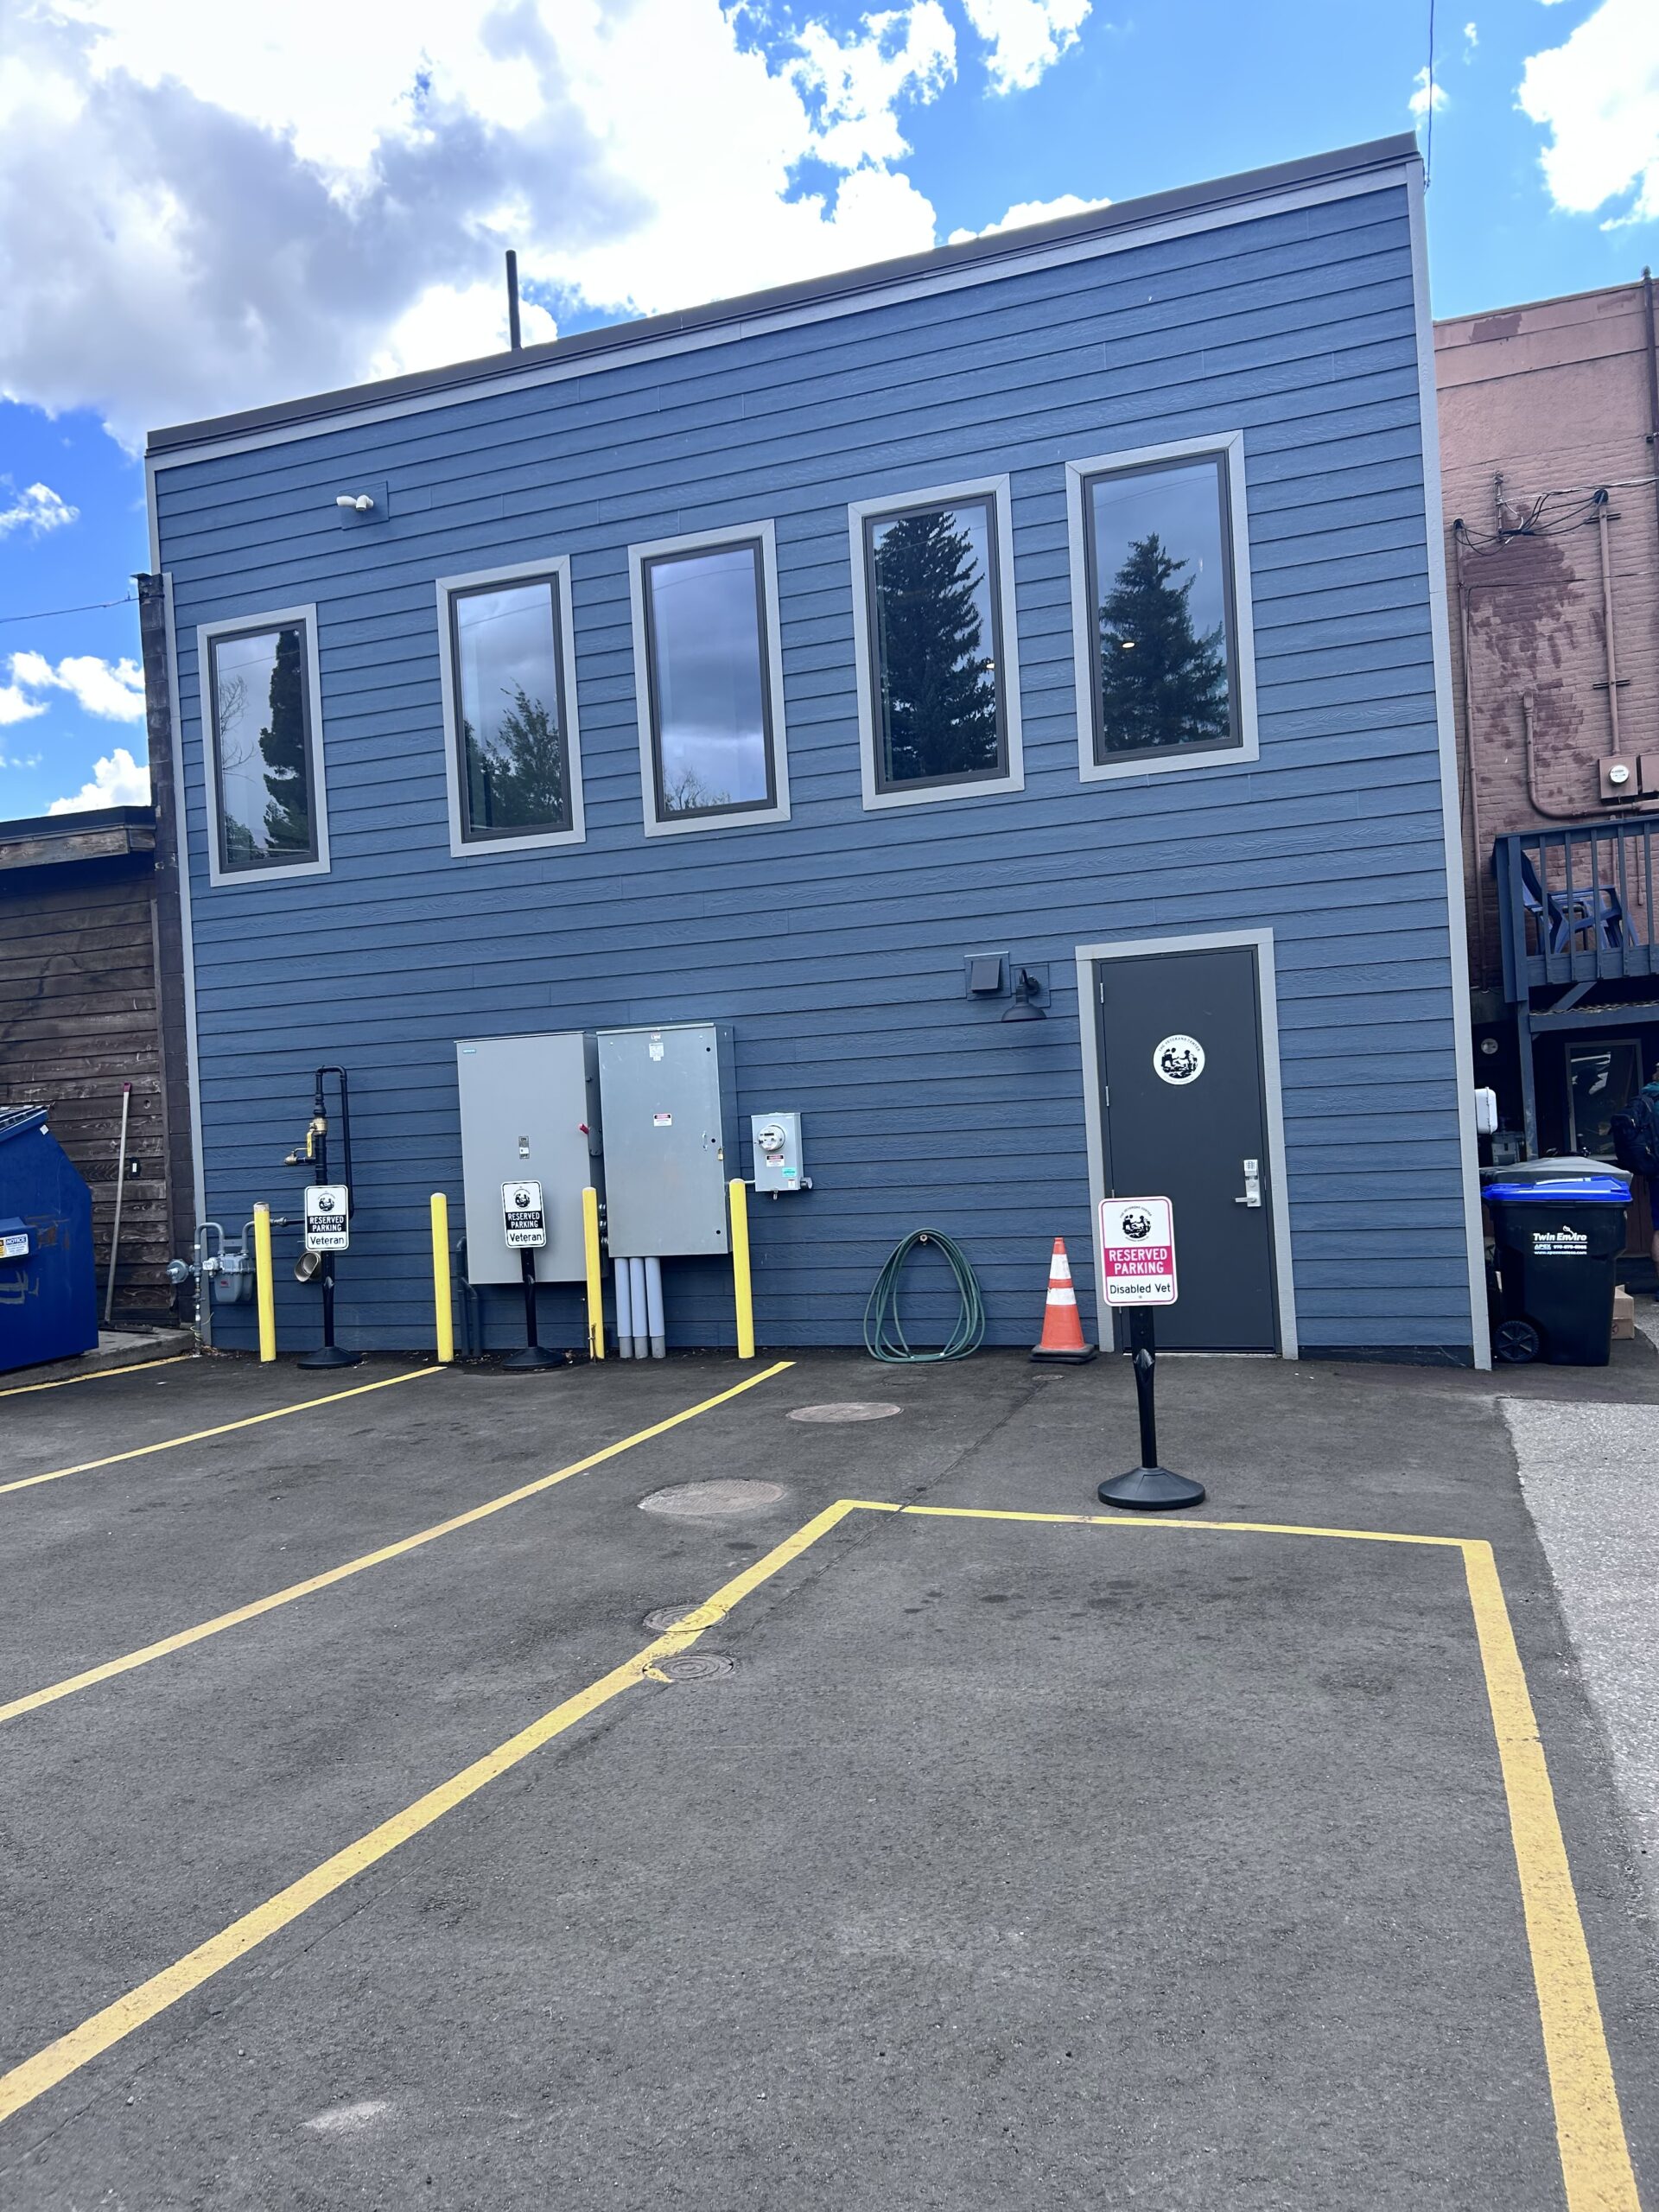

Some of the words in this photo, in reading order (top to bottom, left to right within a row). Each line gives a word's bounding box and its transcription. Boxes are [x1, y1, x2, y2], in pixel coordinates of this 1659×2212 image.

[309, 1216, 345, 1224] RESERVED
[508, 1211, 540, 1221] RESERVED
[312, 1224, 342, 1232] PARKING
[511, 1220, 538, 1229] PARKING
[6, 1236, 27, 1245] NOTICE
[310, 1236, 345, 1245] Veteran
[510, 1233, 543, 1243] Veteran
[1533, 1232, 1555, 1241] Twin
[1556, 1231, 1587, 1241] Enviro
[1109, 1248, 1167, 1262] RESERVED
[1114, 1262, 1164, 1274] PARKING
[1109, 1284, 1151, 1294] Disabled
[1154, 1283, 1171, 1293] Vet
